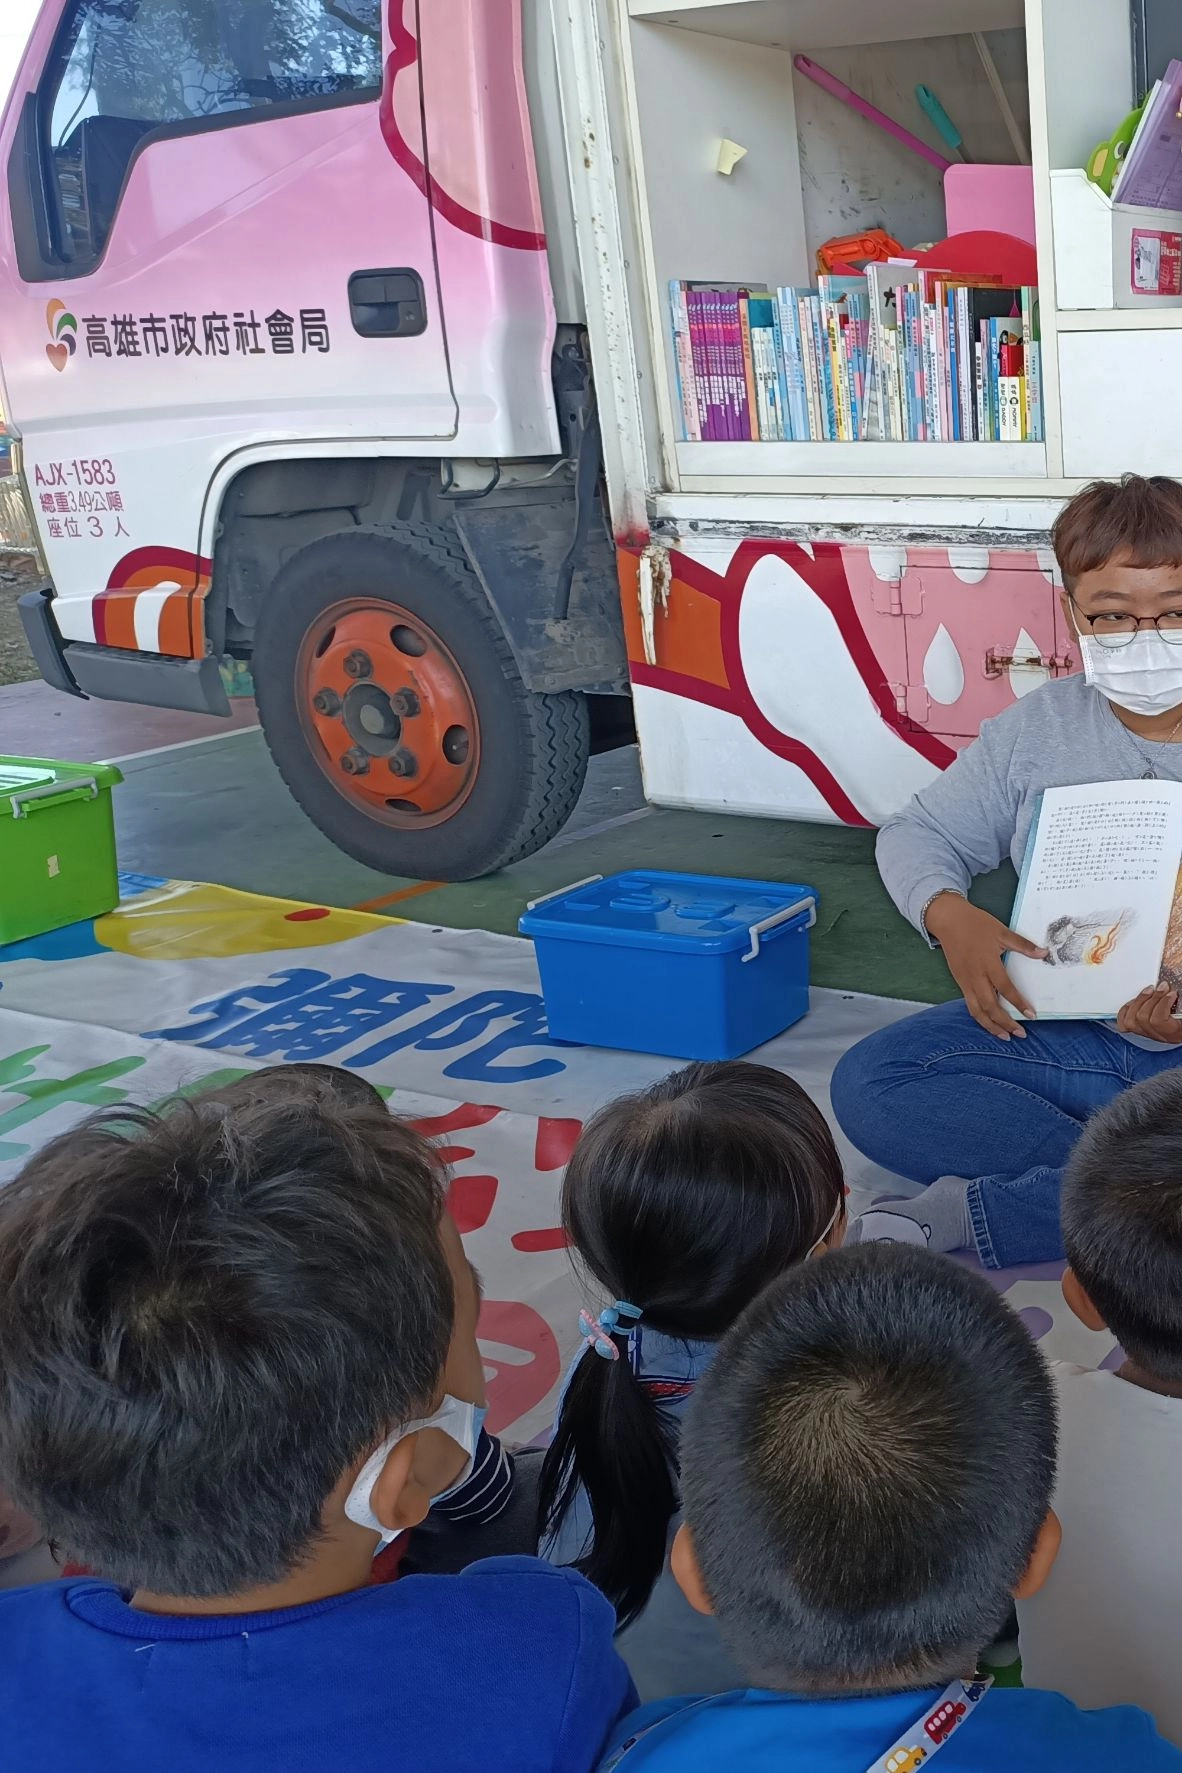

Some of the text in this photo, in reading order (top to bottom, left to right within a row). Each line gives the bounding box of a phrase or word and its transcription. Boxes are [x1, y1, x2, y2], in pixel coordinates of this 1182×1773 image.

[81, 308, 330, 358] 高雄市政府社會局
[34, 459, 116, 487] AJX-1583
[46, 516, 131, 538] 座位 3 人
